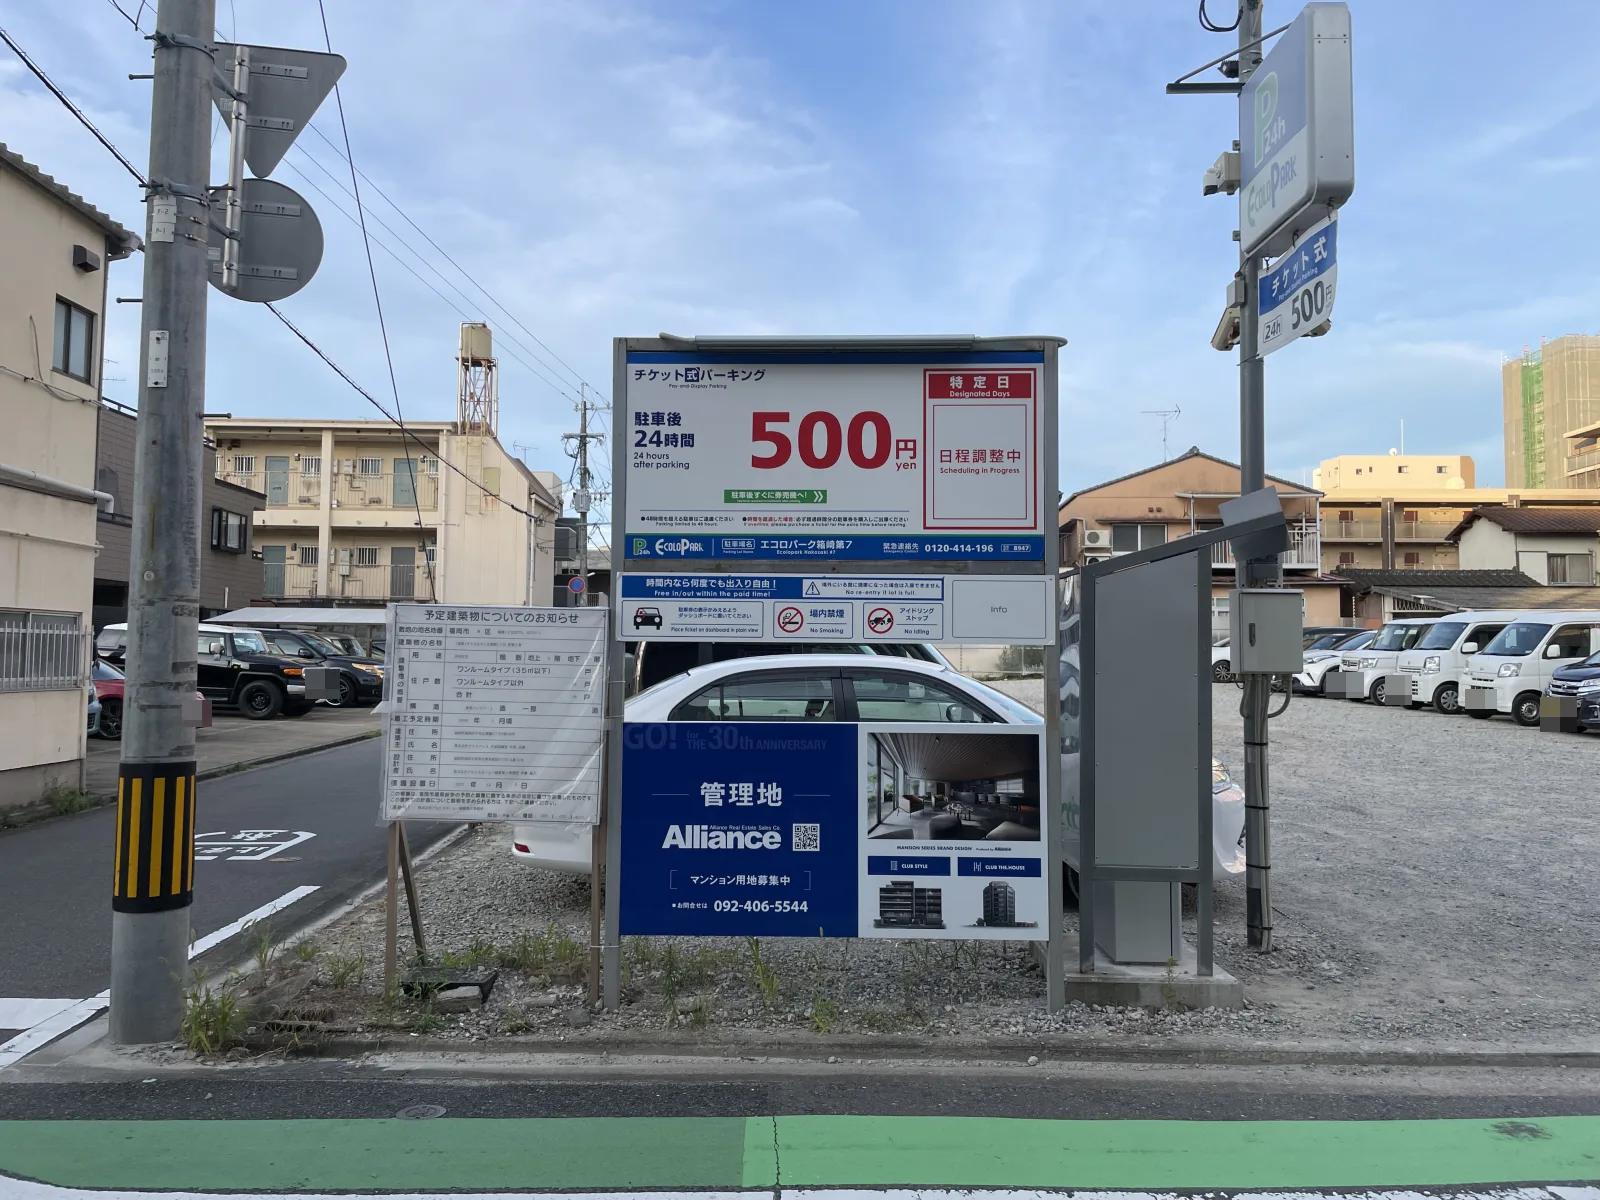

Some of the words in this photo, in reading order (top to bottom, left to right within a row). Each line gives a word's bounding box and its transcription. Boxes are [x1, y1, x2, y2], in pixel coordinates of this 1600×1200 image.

[1254, 71, 1279, 169] P
[1264, 116, 1286, 155] 24h
[1272, 235, 1328, 298] チケット式
[1292, 280, 1325, 330] 500
[1264, 320, 1281, 340] 24h
[634, 367, 767, 382] チケット式パーキング
[949, 375, 1010, 389] 特定日
[949, 391, 991, 399] Designated
[634, 412, 682, 427] 駐車後
[634, 430, 695, 448] 24時間
[751, 411, 892, 470] 500
[895, 439, 917, 460] 円
[633, 452, 644, 460] 24
[646, 452, 670, 460] hours
[940, 449, 1021, 464] 日程調整中
[633, 461, 654, 469] after
[656, 461, 690, 470] parking
[895, 462, 917, 471] yen
[940, 467, 980, 475] Scheduling
[989, 467, 1020, 475] Progress
[724, 540, 753, 548] 駐車場名
[924, 544, 994, 552] 0120-414-196
[733, 590, 750, 598] paid
[424, 609, 579, 624] 予定建築物についてのお知らせ
[809, 609, 845, 618] 場内禁煙
[456, 678, 524, 687] ワンルームタイプ以外
[686, 730, 700, 739] for
[407, 741, 438, 749] 氏名
[687, 739, 707, 750] THE
[756, 739, 828, 751] ANNIVERSARY
[699, 781, 783, 807] 管理地
[661, 824, 782, 850] Alliance
[690, 875, 791, 886] マンション用地募集中
[713, 900, 809, 912] 092-406-5544
